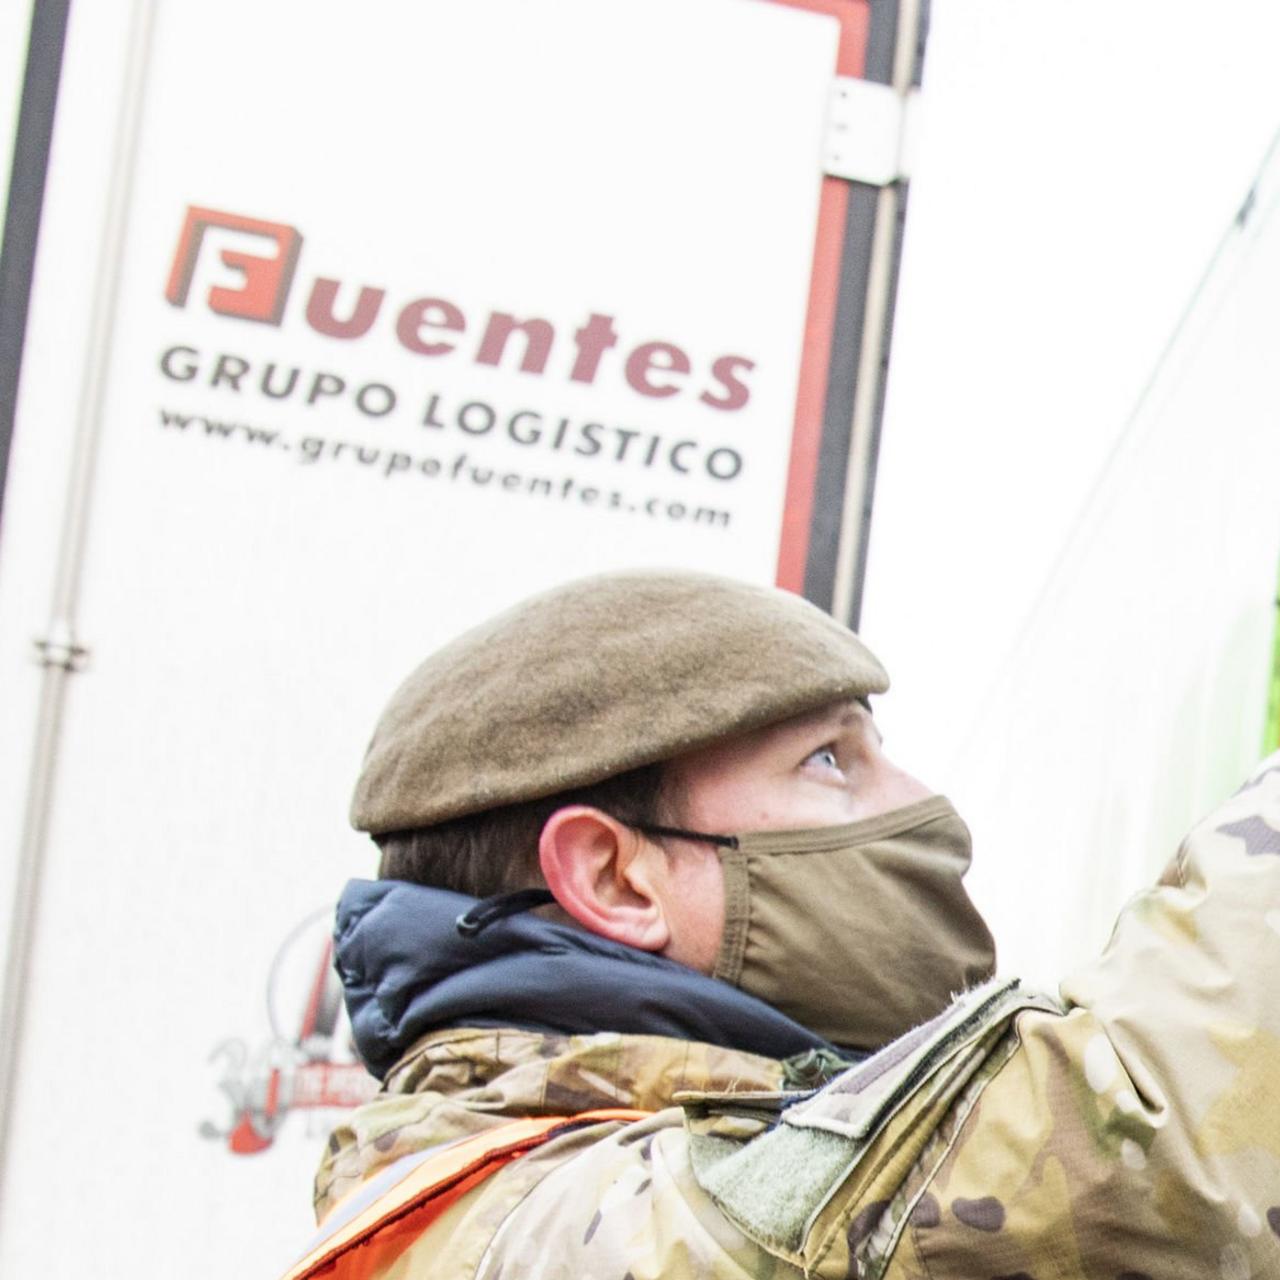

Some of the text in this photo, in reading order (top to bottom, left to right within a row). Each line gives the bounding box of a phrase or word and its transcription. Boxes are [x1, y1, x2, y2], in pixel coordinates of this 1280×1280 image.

[164, 204, 757, 411] Fuentes
[159, 345, 744, 481] GRUPO LOGISTICO
